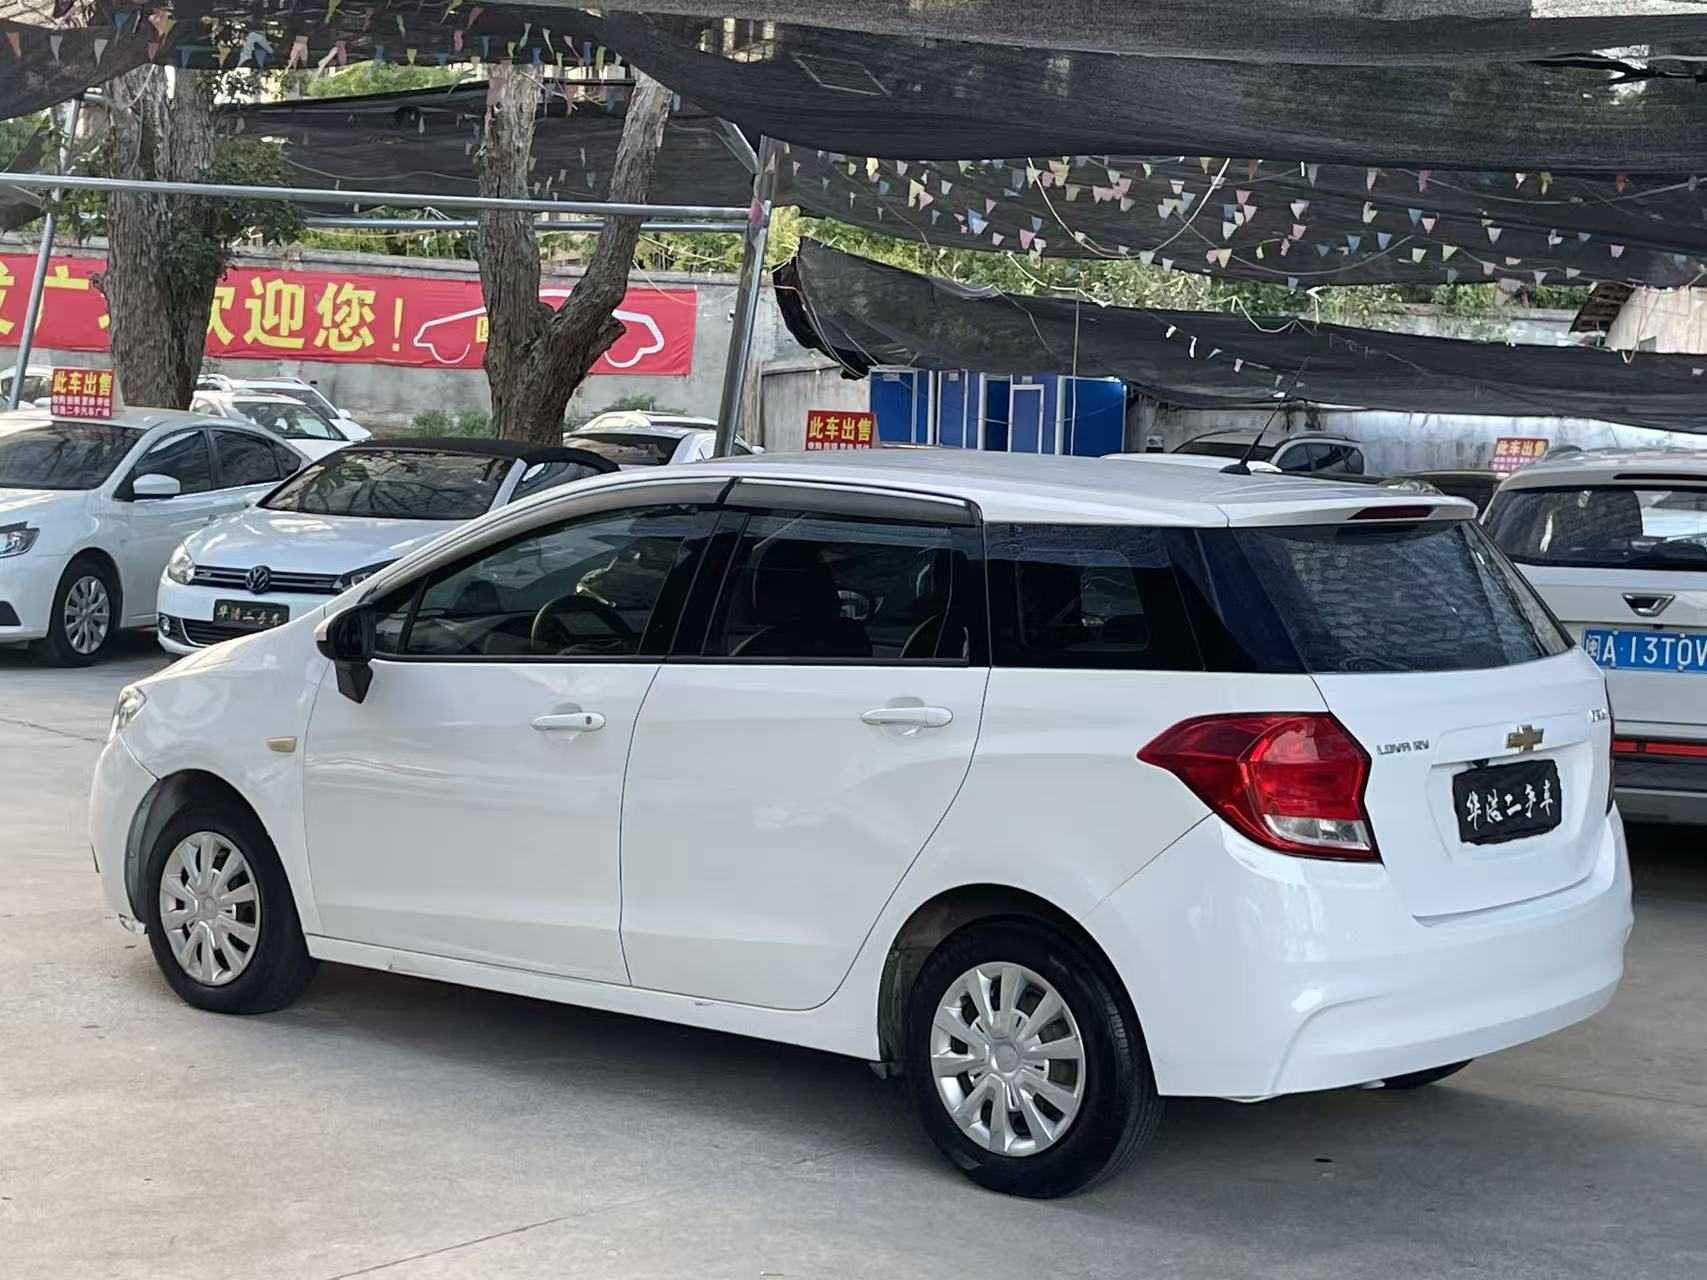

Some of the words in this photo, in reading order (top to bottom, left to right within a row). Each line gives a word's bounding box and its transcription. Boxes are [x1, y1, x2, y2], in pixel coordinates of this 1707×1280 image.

[53, 370, 112, 396] 此车出售
[808, 416, 872, 441] 此车出售
